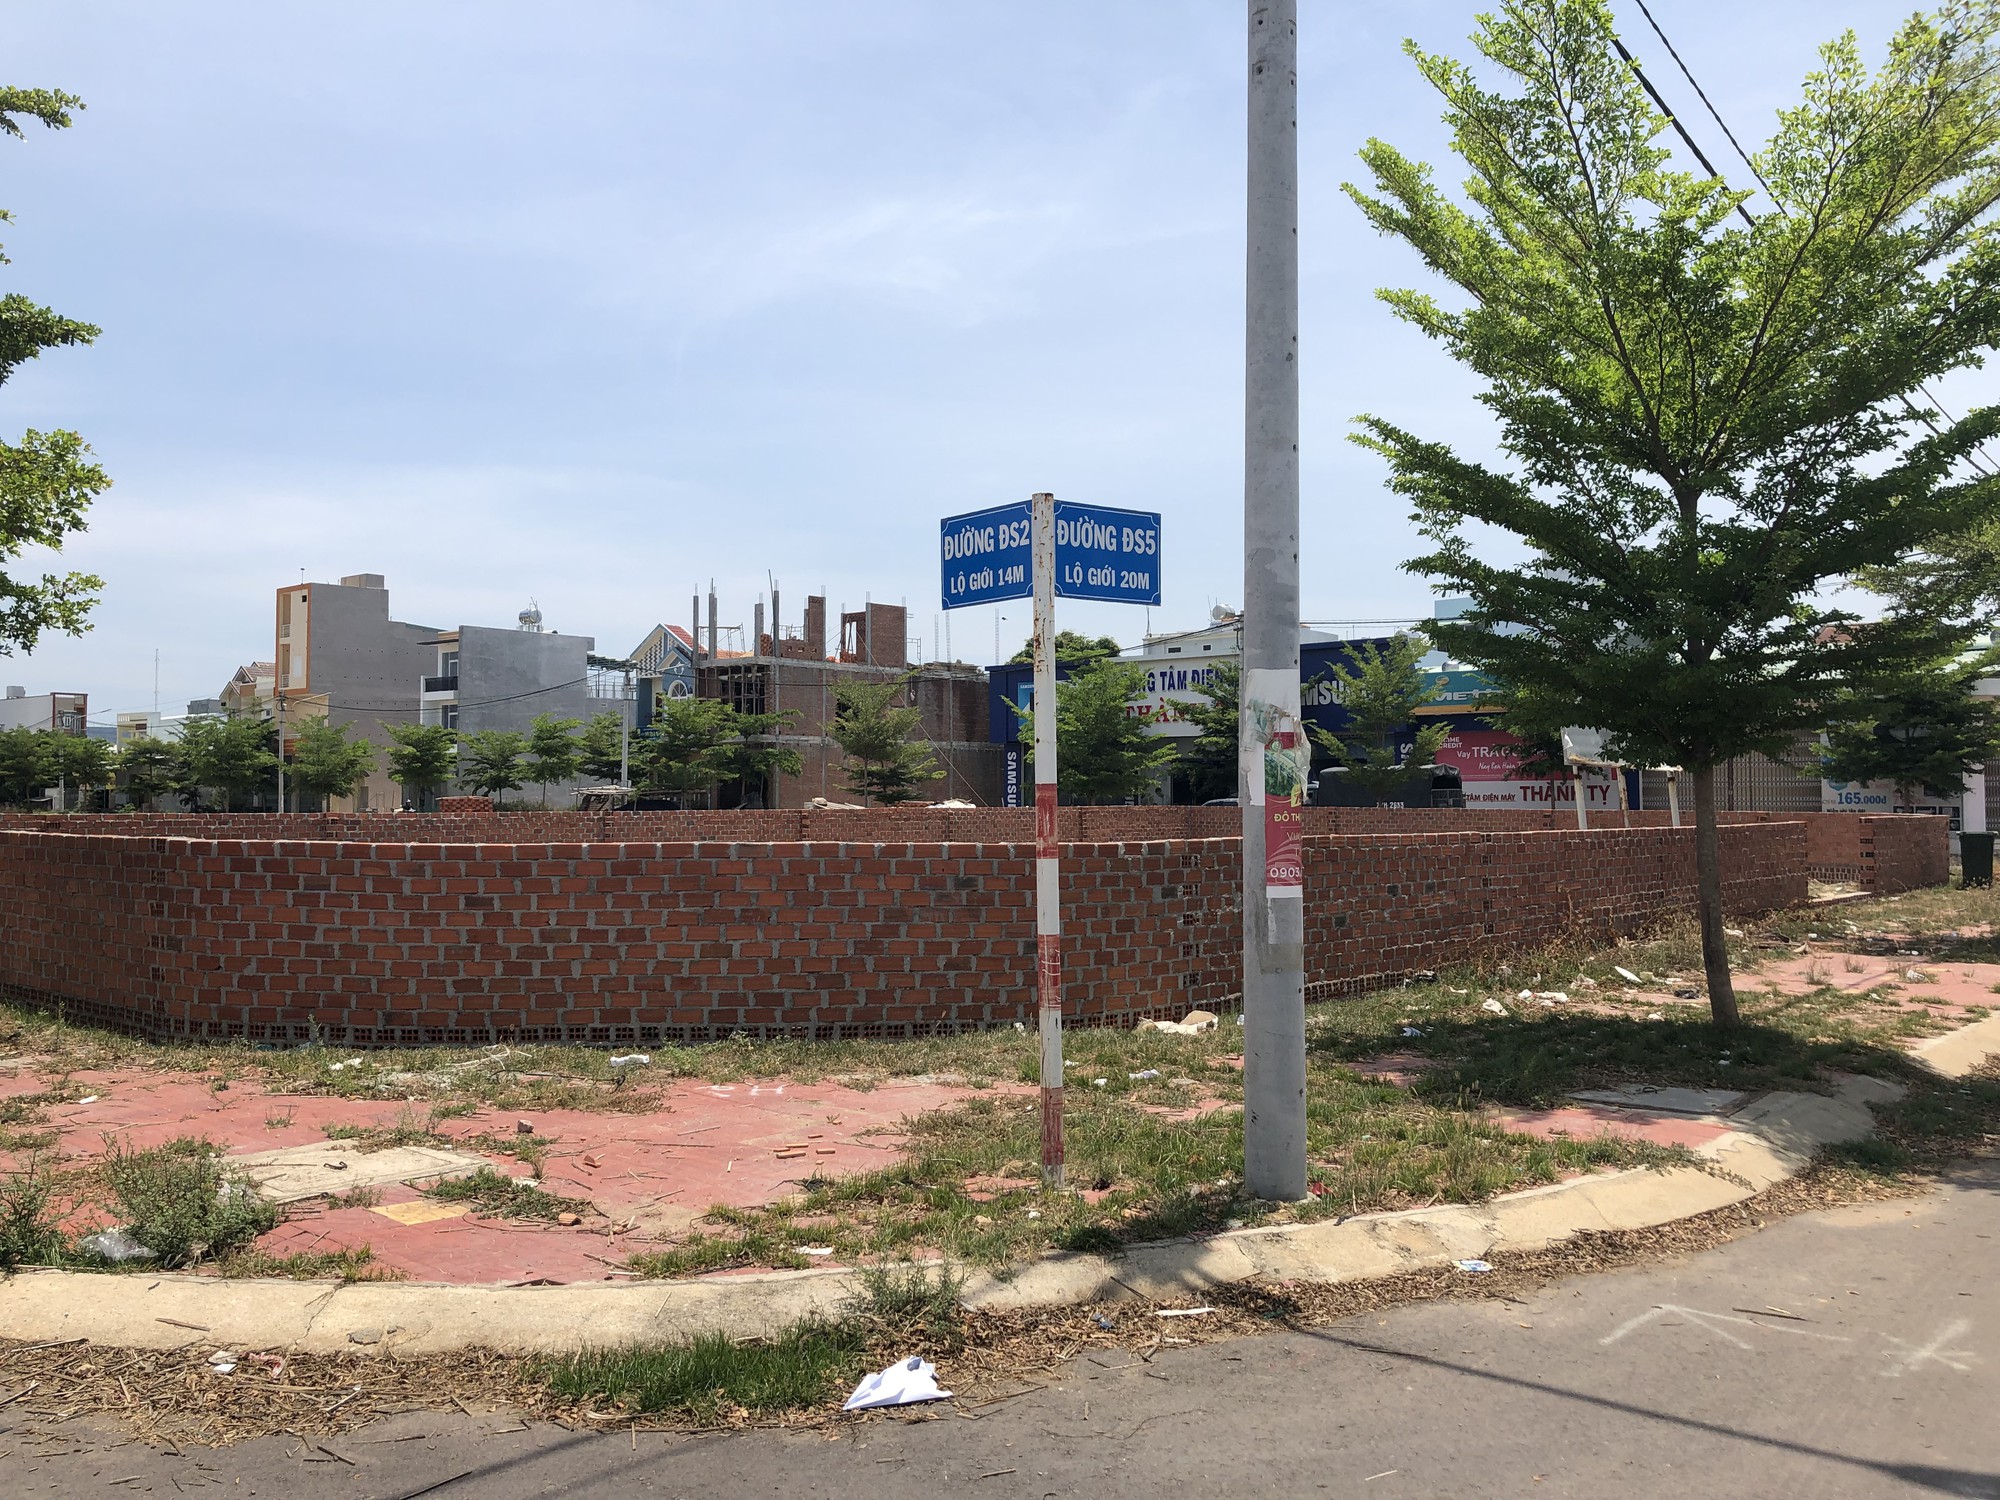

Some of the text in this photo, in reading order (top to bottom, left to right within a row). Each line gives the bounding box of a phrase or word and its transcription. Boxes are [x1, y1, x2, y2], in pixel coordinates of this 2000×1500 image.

[944, 520, 1030, 560] ĐƯỜNG ĐS2
[1057, 516, 1156, 555] ĐƯỜNG ĐS5
[951, 564, 1024, 596] LỘ GIỚI 14M
[1065, 562, 1150, 590] LỘ GIỚI 20M
[1160, 665, 1187, 691] TÂM
[1456, 750, 1471, 759] Vay
[1466, 792, 1481, 801] TÂM
[1482, 792, 1499, 803] ĐIỆN
[1500, 792, 1516, 801] MÁY
[1274, 810, 1290, 822] ĐÔ
